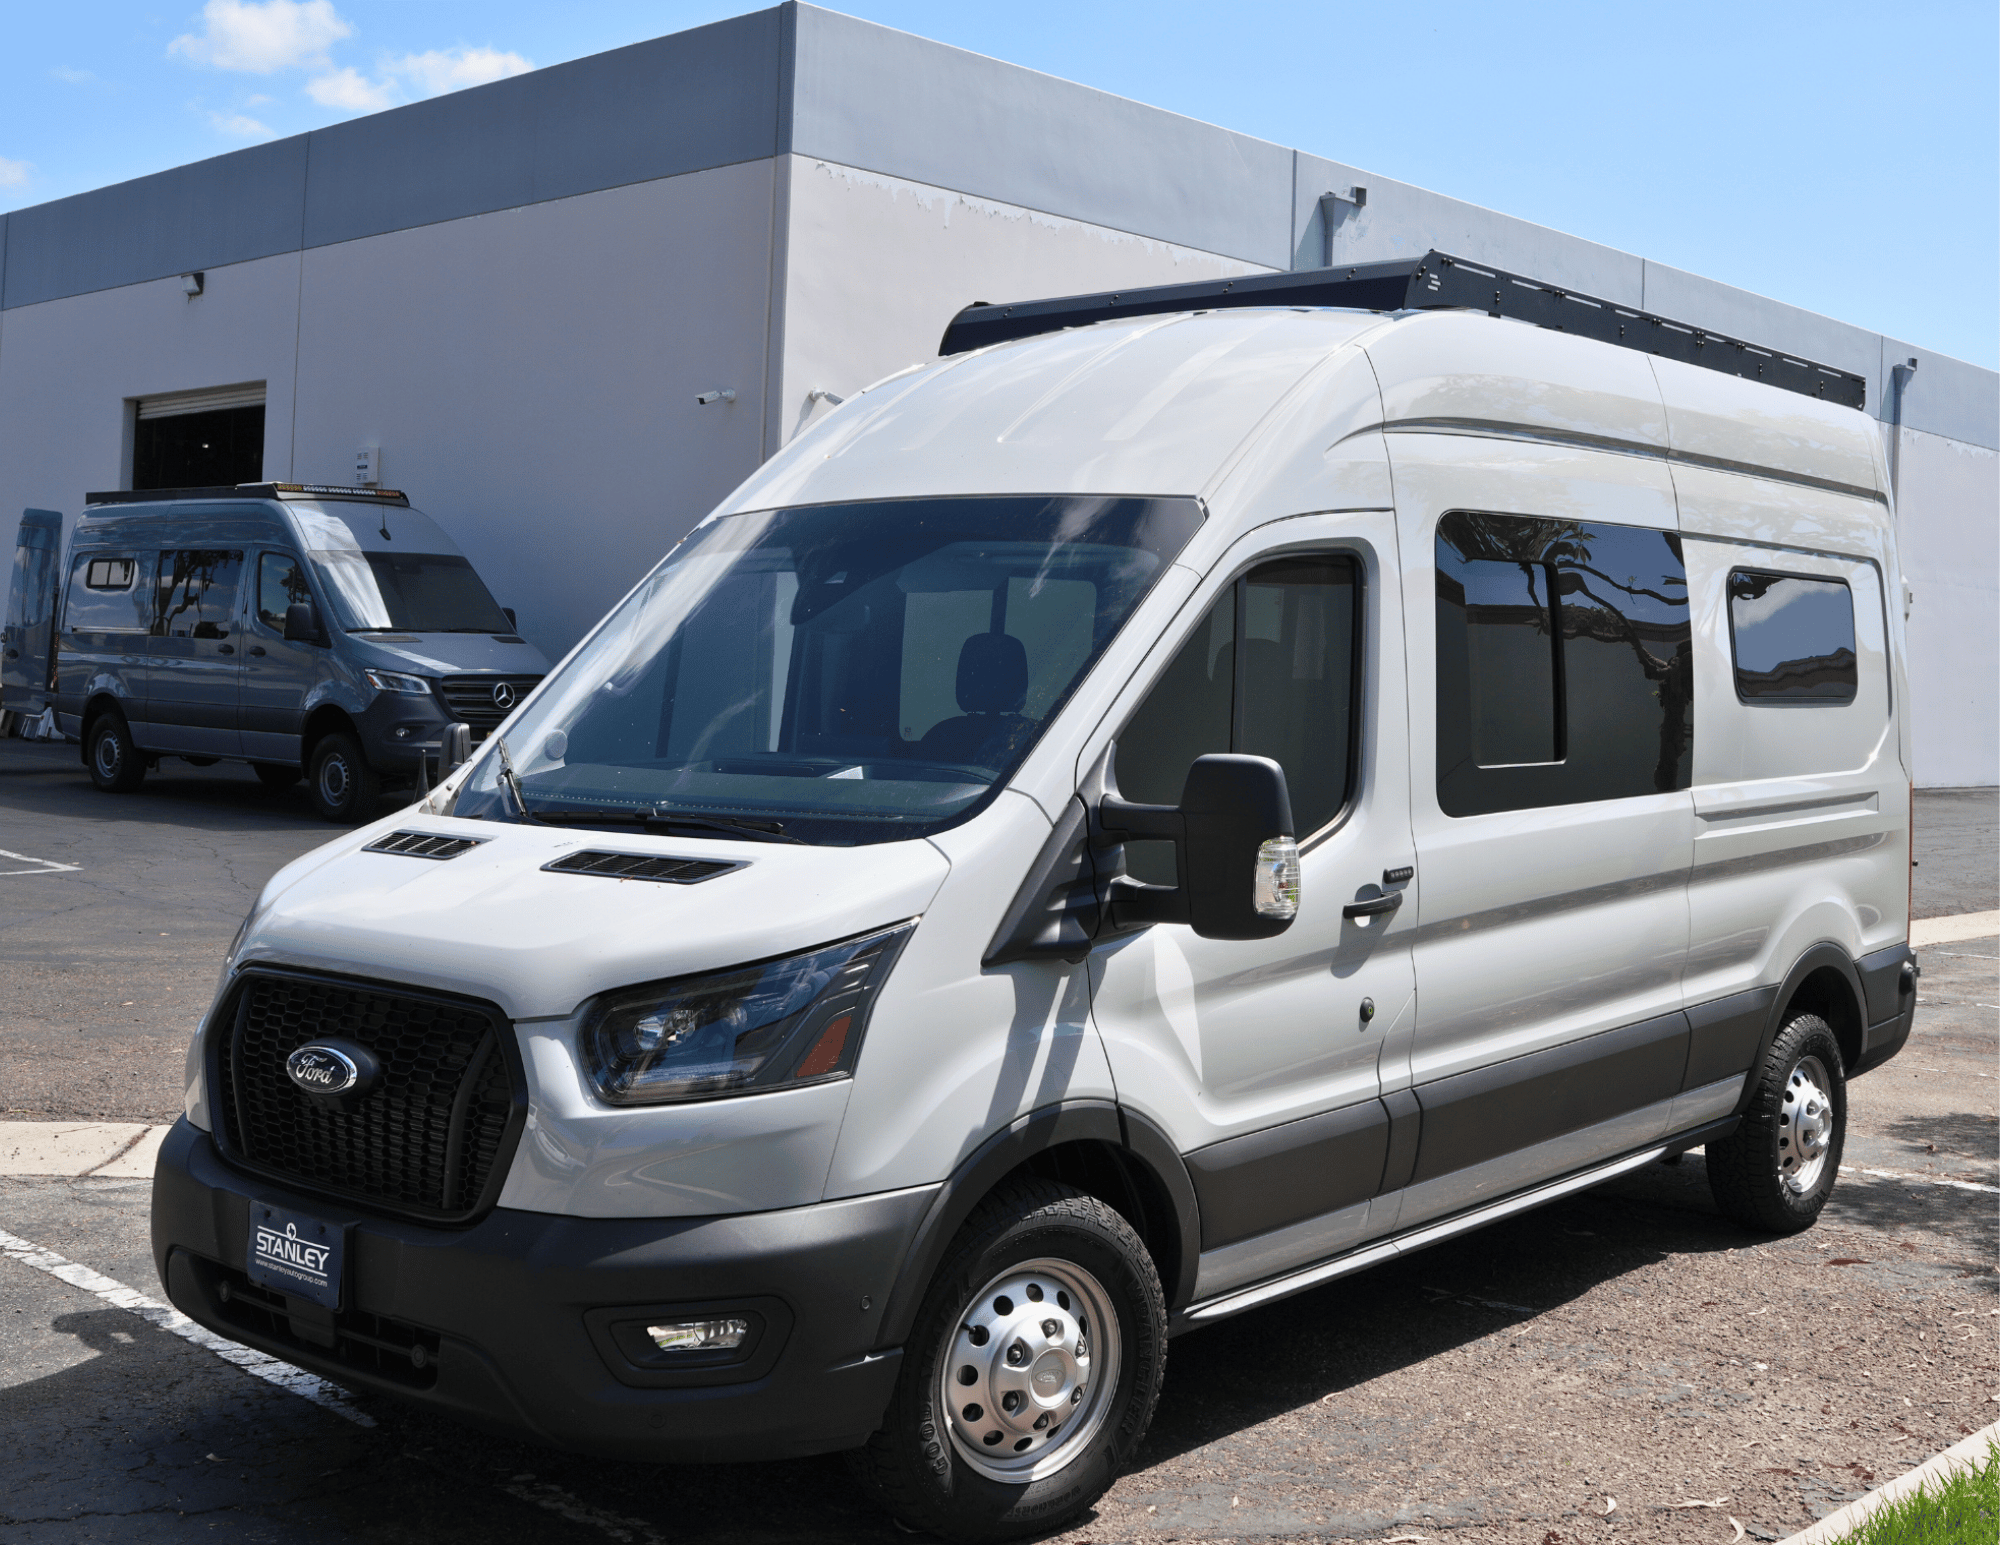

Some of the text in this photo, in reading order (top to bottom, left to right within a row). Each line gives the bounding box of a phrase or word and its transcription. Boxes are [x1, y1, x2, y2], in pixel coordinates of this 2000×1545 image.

[296, 1053, 336, 1084] Ford
[256, 1231, 330, 1271] STANLEY
[255, 1258, 328, 1287] www.stanleyautogroup.com
[1121, 1278, 1153, 1434] WRANGLER
